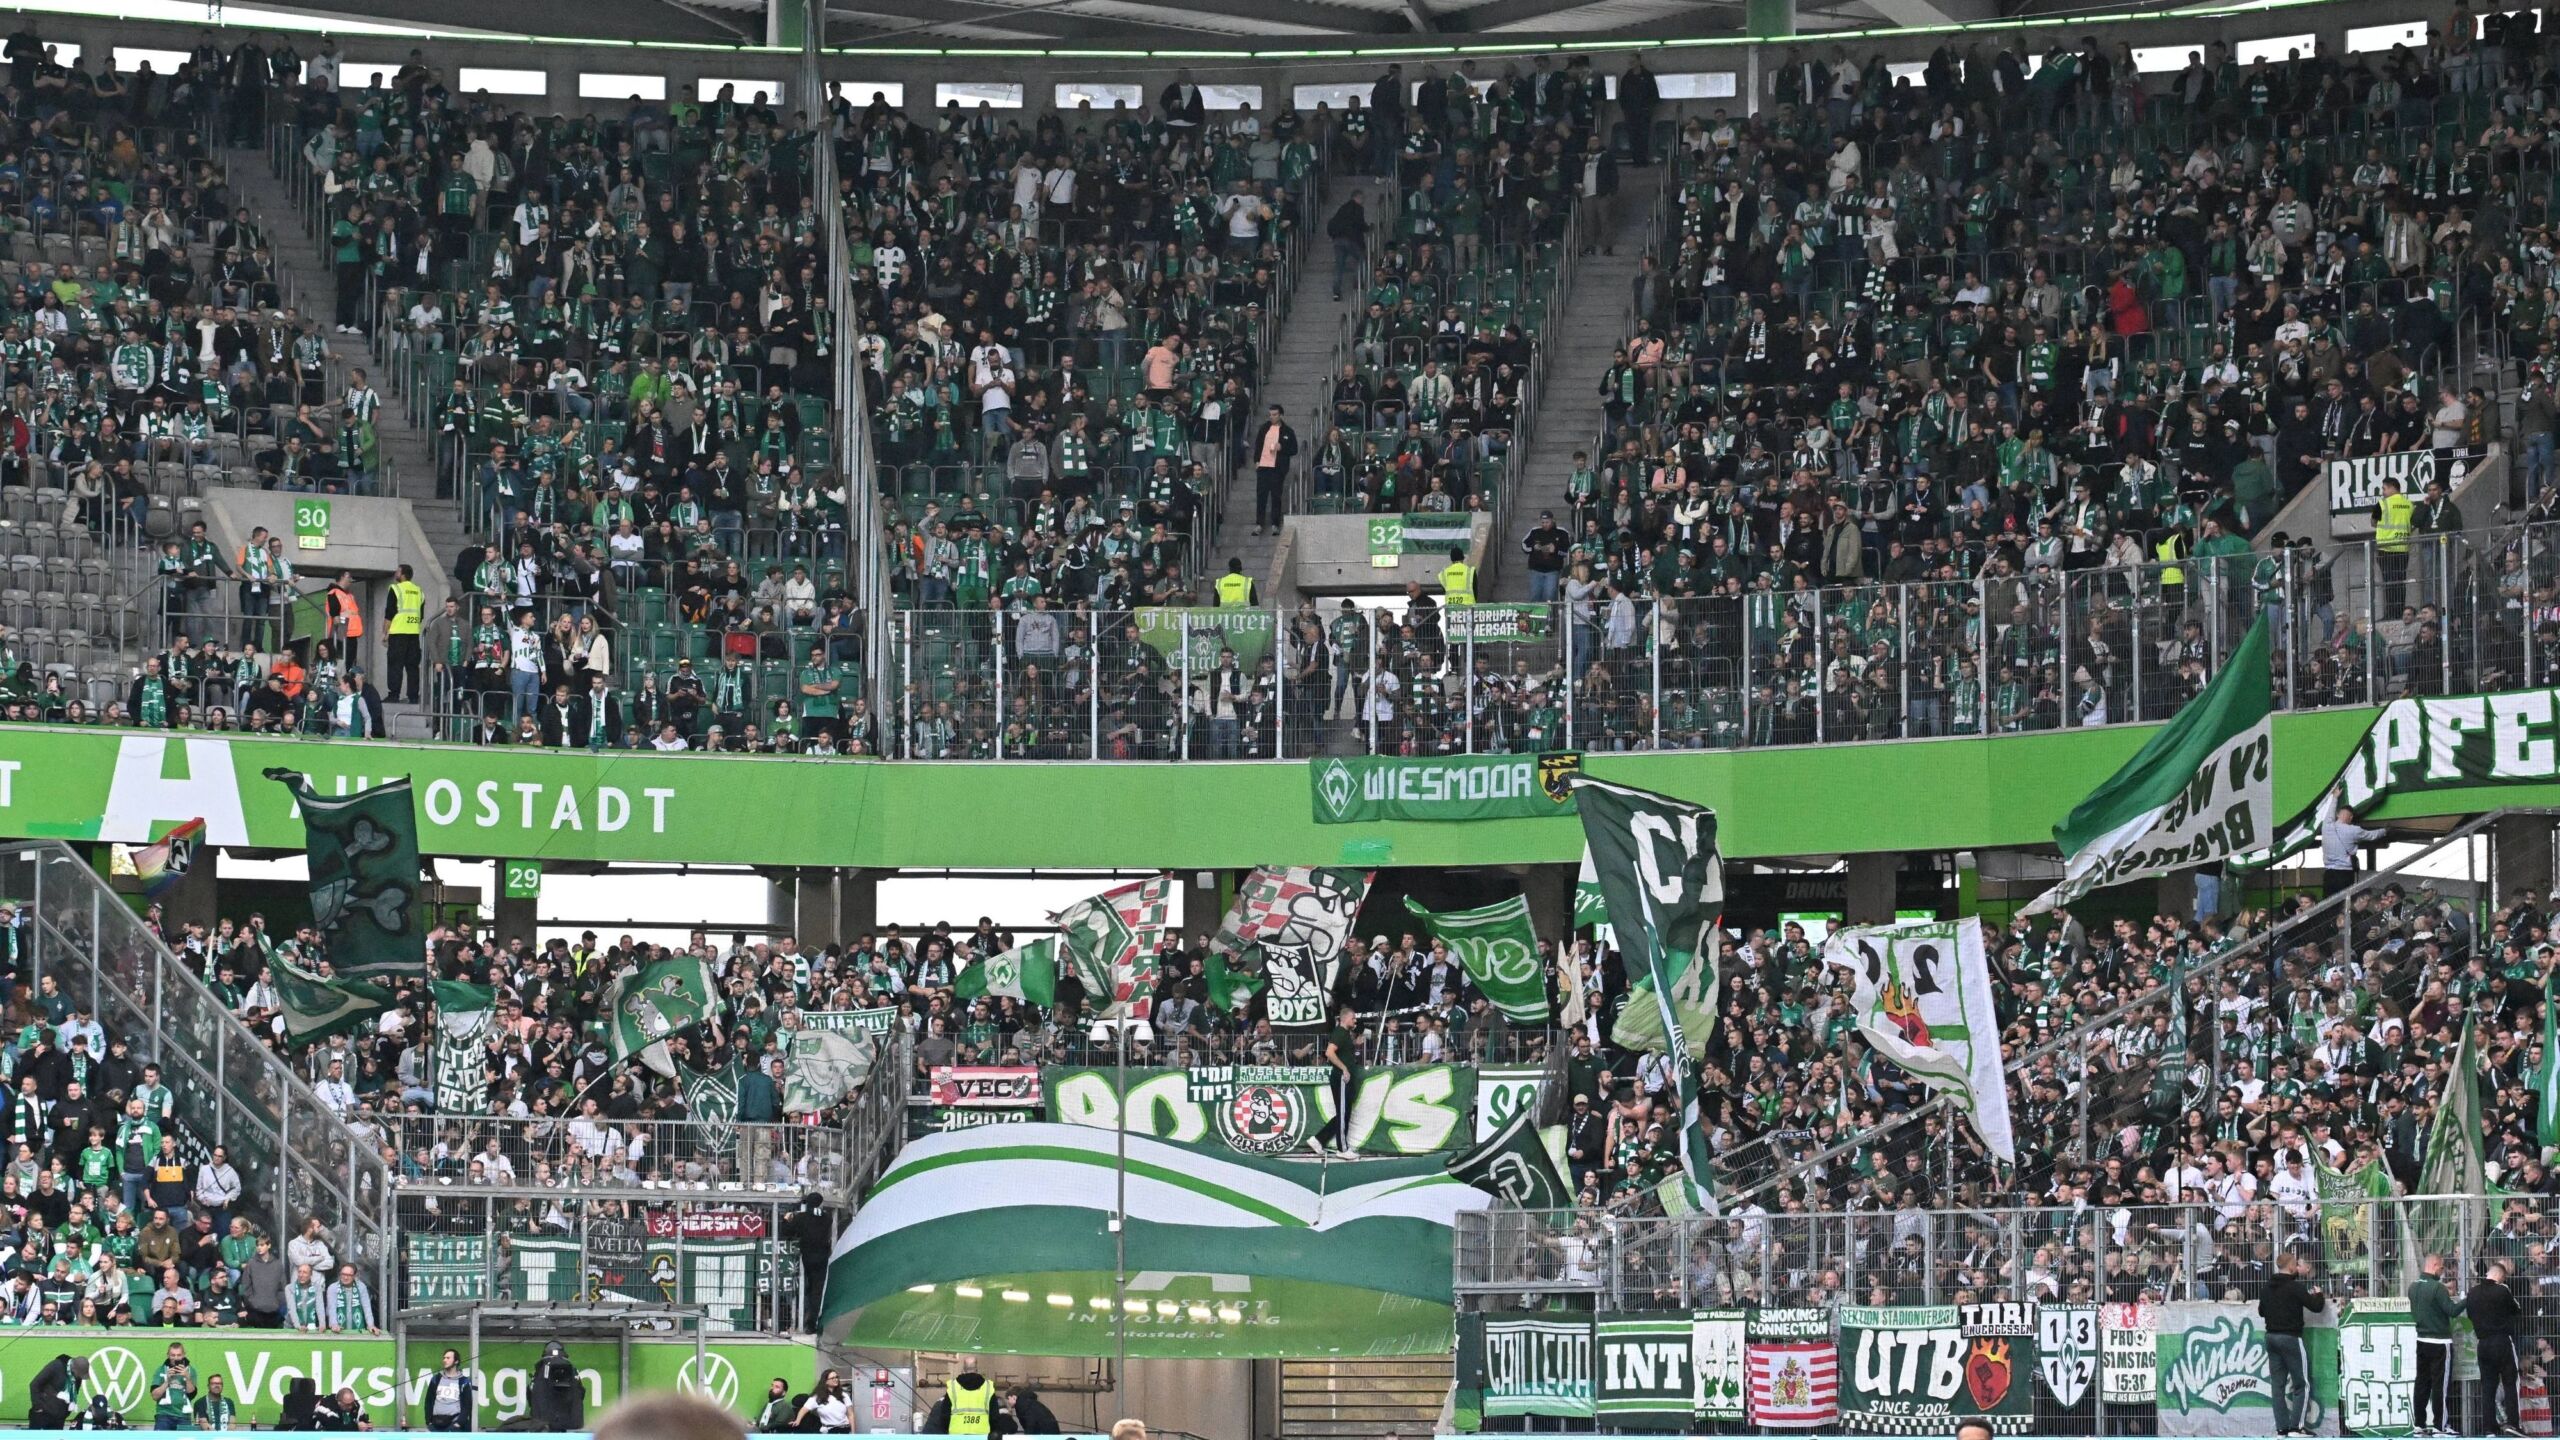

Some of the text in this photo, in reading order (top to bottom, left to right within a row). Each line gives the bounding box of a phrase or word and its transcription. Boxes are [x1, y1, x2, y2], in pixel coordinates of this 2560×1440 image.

[2452, 448, 2469, 457] TOBI
[297, 508, 327, 527] 30
[1371, 525, 1401, 544] 32
[1449, 608, 1519, 623] REIEGRUPPE
[1364, 763, 1531, 801] WIESMOOR
[509, 868, 538, 888] 29
[1267, 996, 1320, 1023] BOYS
[1189, 1066, 1233, 1083] תמיד
[1231, 1130, 1295, 1153] BREMEN
[602, 1222, 625, 1236] RIP
[1760, 1308, 1818, 1323] SMOKING
[1748, 1321, 1827, 1336] CONNECTION
[1962, 1324, 2033, 1337] UNVERGESSEN
[2110, 1330, 2134, 1346] PRO
[1604, 1343, 1688, 1390] INT
[1855, 1328, 1969, 1400] UTB
[2103, 1351, 2156, 1369] SAMSTAG
[2115, 1373, 2147, 1391] 15:30
[2216, 1378, 2258, 1403] Bremen
[1870, 1400, 1951, 1417] SINCE 2002
